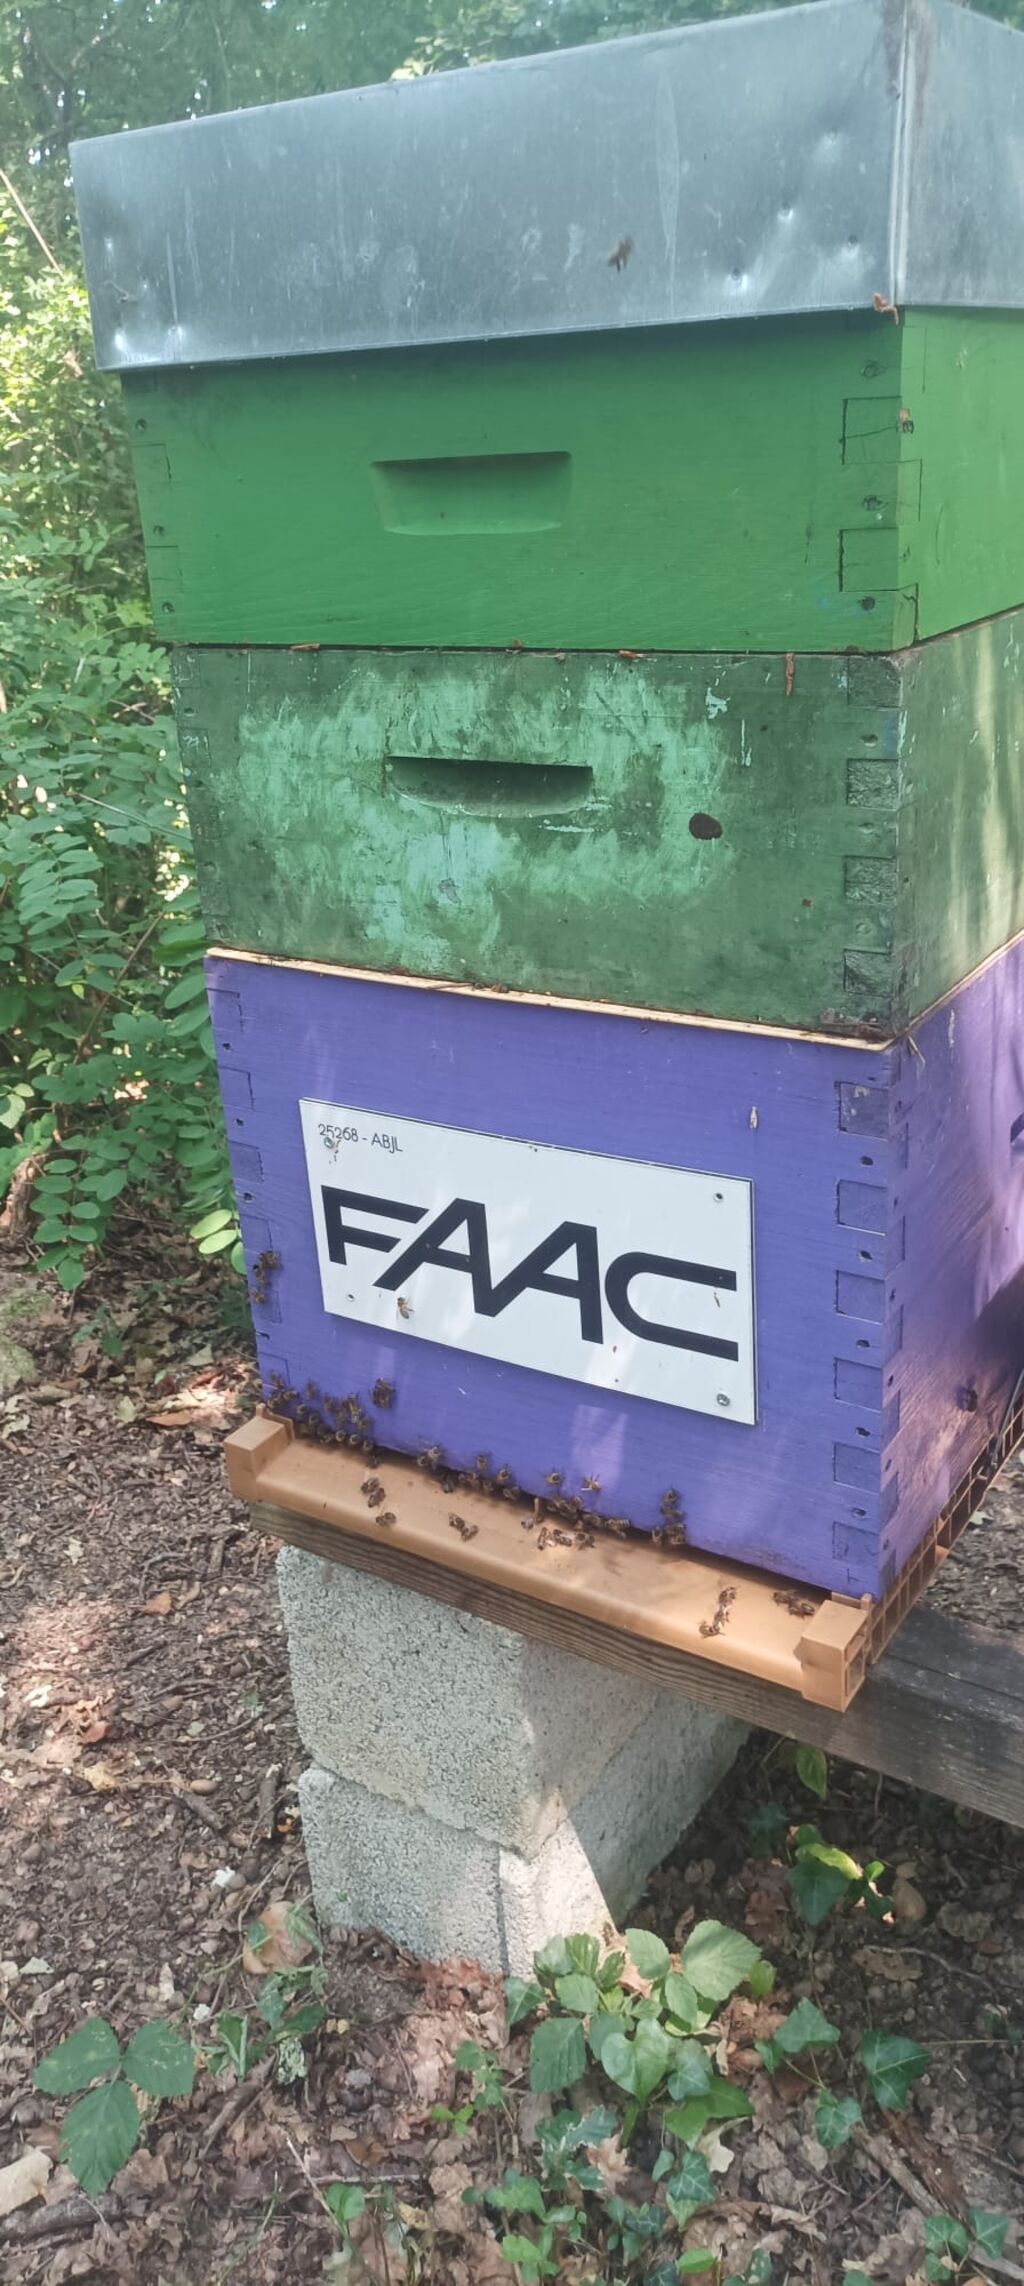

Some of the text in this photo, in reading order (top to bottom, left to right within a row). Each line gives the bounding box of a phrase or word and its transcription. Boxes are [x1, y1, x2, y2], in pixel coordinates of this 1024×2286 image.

[317, 1123, 359, 1142] 25268
[371, 1132, 403, 1154] ABJL
[321, 1184, 739, 1362] FAAC
